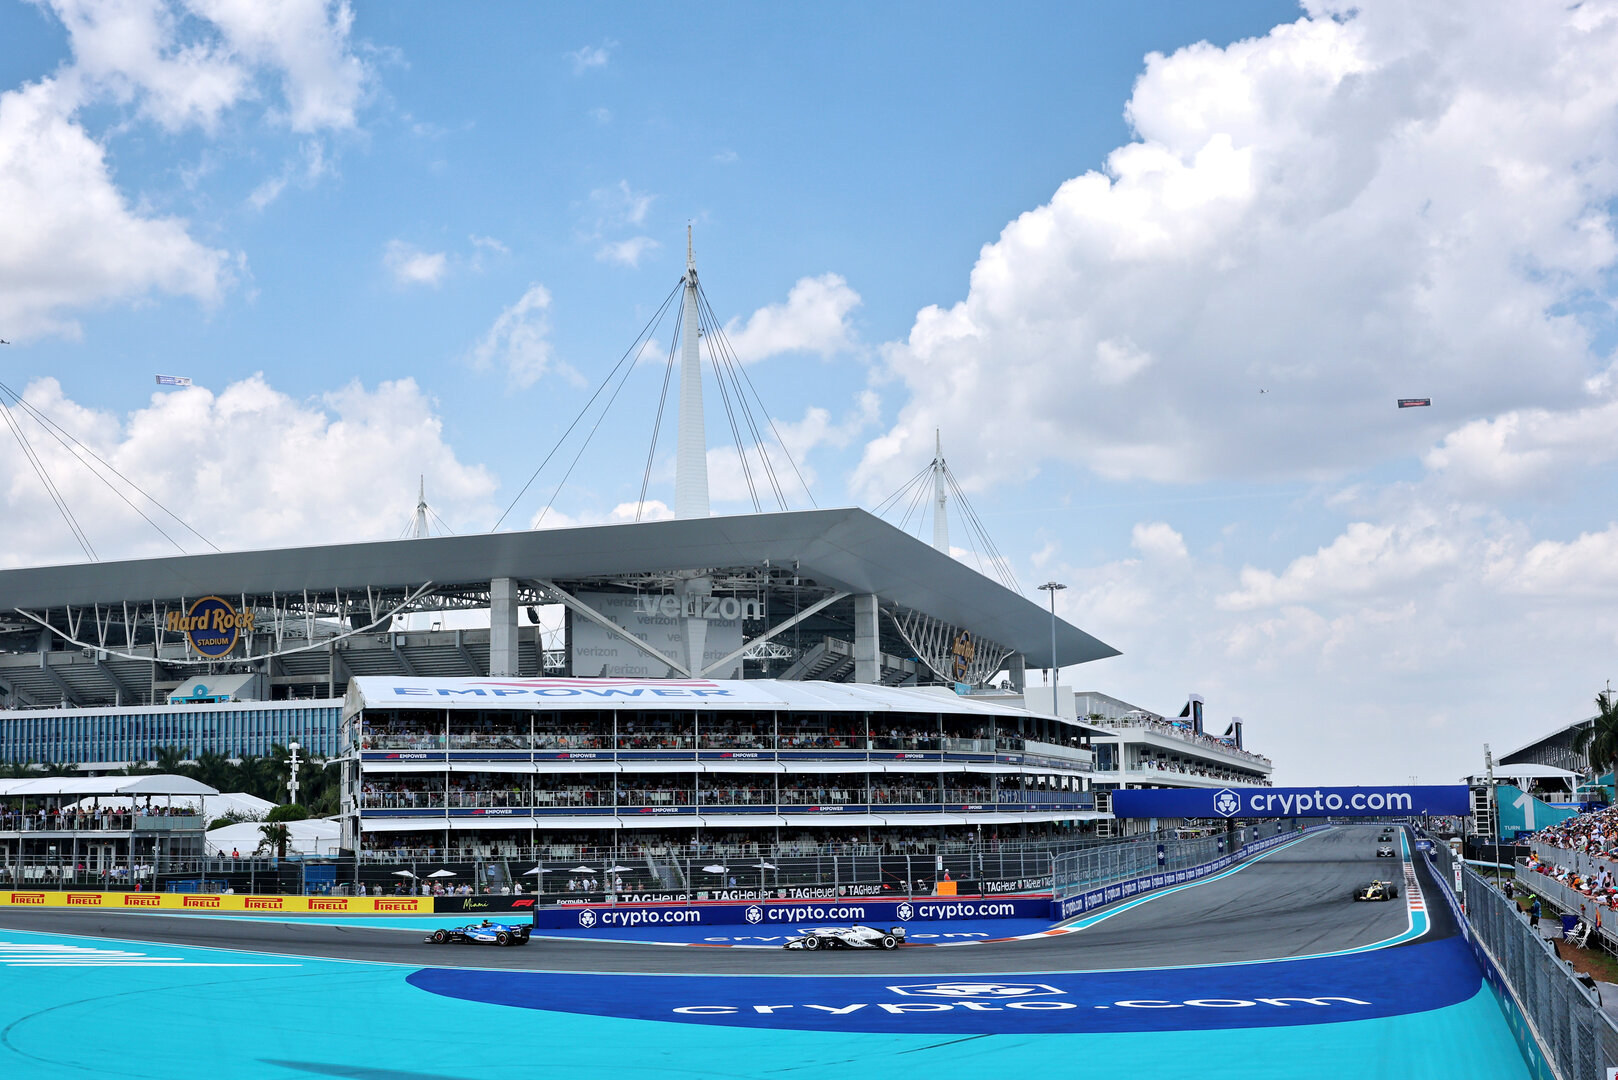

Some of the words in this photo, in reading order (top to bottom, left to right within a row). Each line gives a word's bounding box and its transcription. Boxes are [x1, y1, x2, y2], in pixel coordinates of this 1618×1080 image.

[641, 594, 760, 620] verizon
[167, 609, 210, 632] Hard
[212, 606, 255, 633] Rock
[637, 614, 677, 625] verizon
[197, 638, 229, 646] STADIUM
[576, 646, 617, 656] verizon
[703, 649, 728, 659] erizo
[608, 664, 648, 674] verizon
[392, 687, 735, 697] EMPOWER
[1250, 790, 1412, 815] crypto.com
[1512, 792, 1535, 830] 1
[11, 893, 45, 904] PIRELLI
[67, 893, 102, 905] PIRELLI
[124, 894, 160, 906] PIRELLI
[183, 895, 220, 907] PIRELLI
[245, 897, 283, 909] PIRELLI
[308, 898, 348, 910] PIRELLI
[374, 899, 418, 910] PIRELLI
[463, 898, 488, 910] Miami
[768, 906, 865, 922] crypto.com
[919, 903, 1014, 919] crypto.com
[602, 909, 700, 926] crypto.com
[672, 997, 1372, 1014] crypto.com
